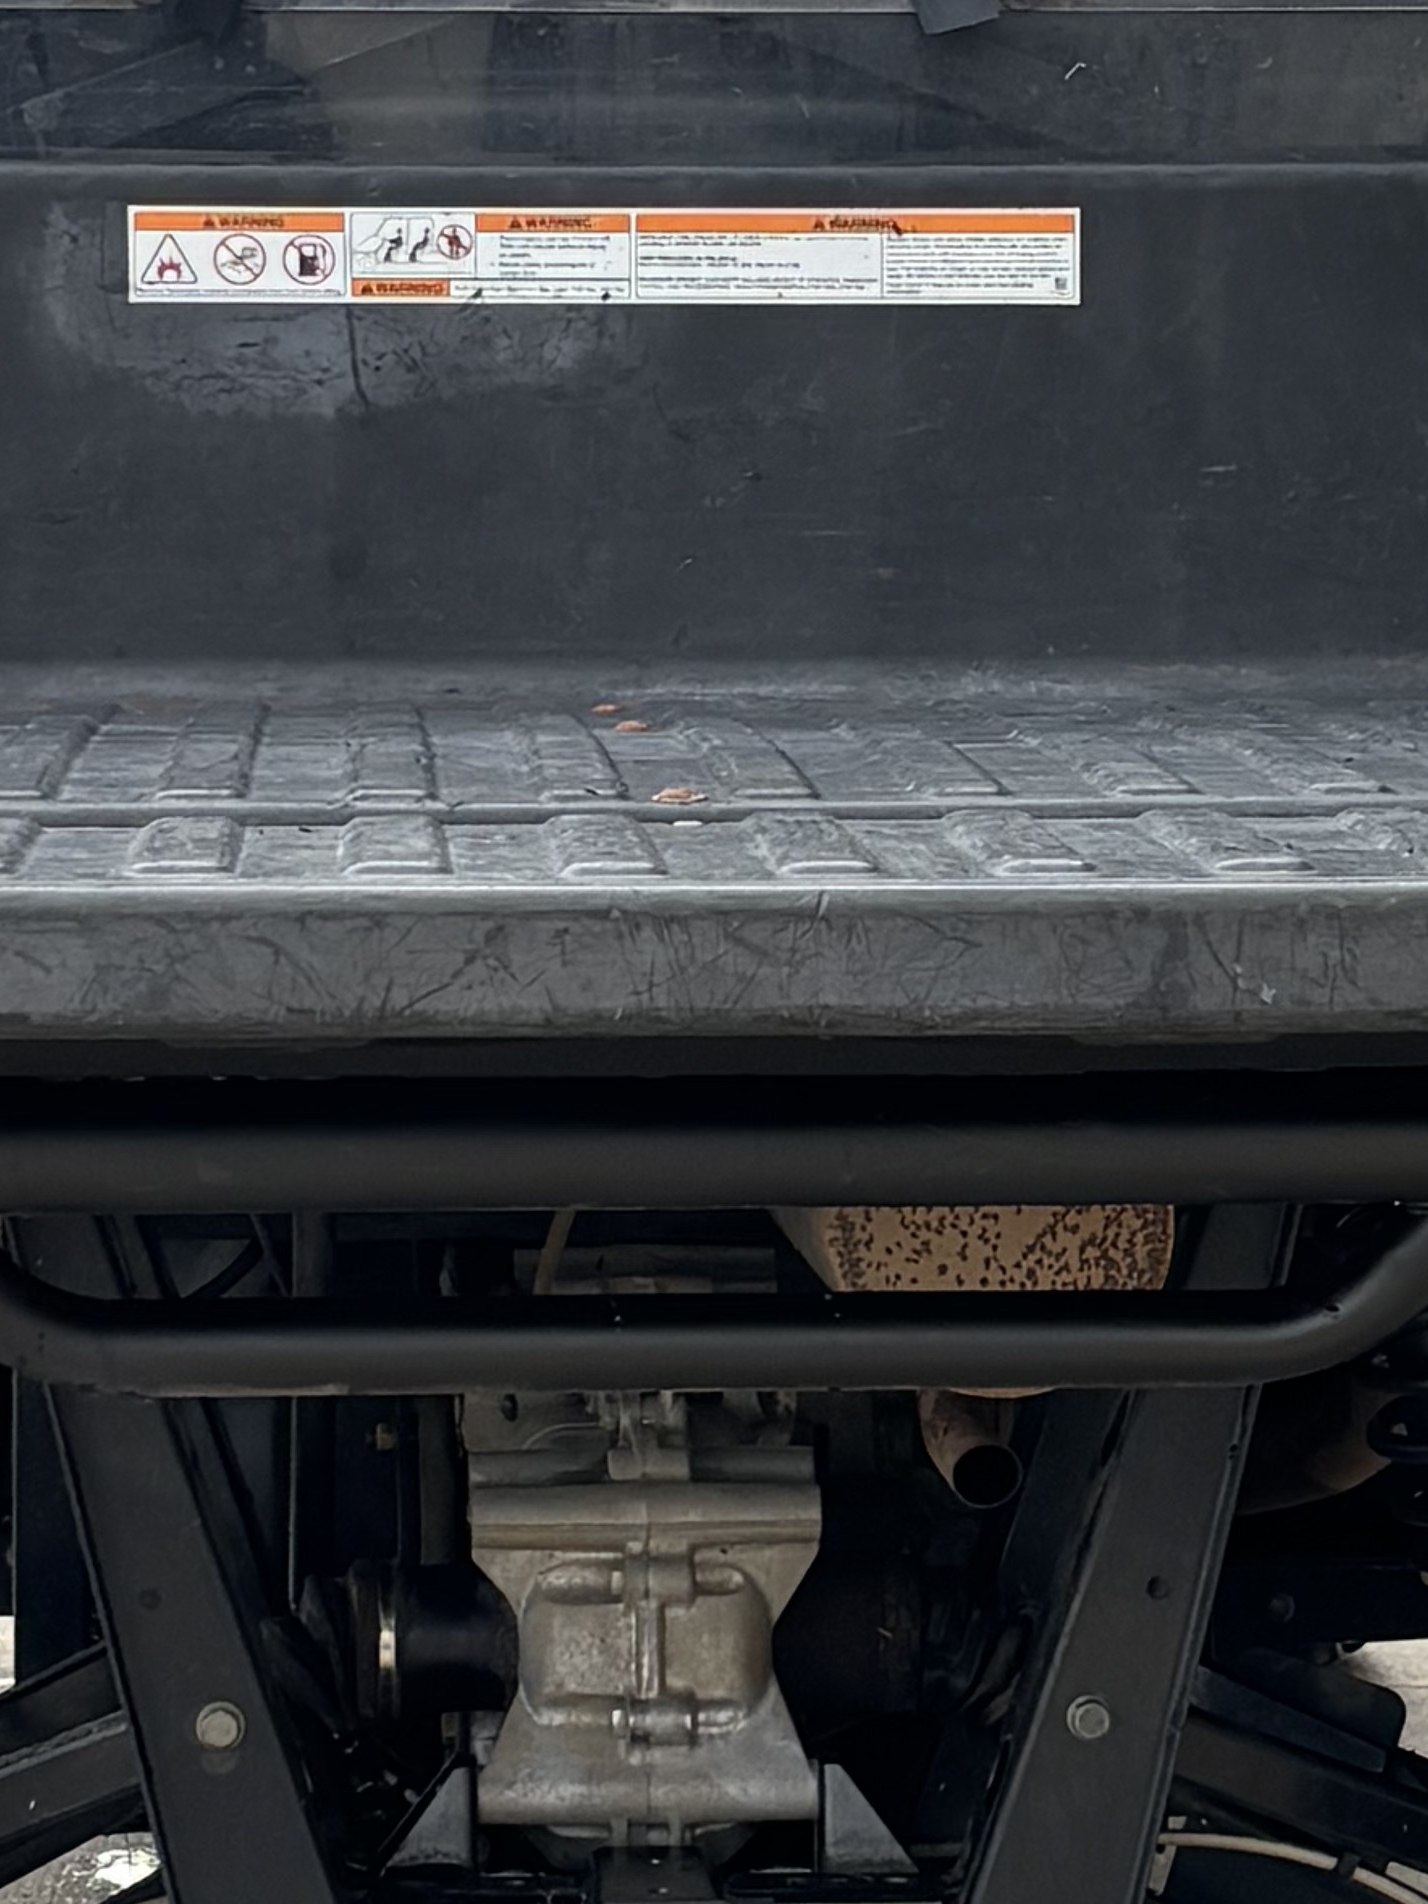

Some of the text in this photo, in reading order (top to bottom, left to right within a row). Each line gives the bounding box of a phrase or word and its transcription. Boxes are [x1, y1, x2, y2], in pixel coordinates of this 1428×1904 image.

[219, 216, 285, 229] WARNING
[525, 217, 592, 230] WARNING
[829, 216, 897, 230] WARNING
[375, 282, 444, 294] WARNING
